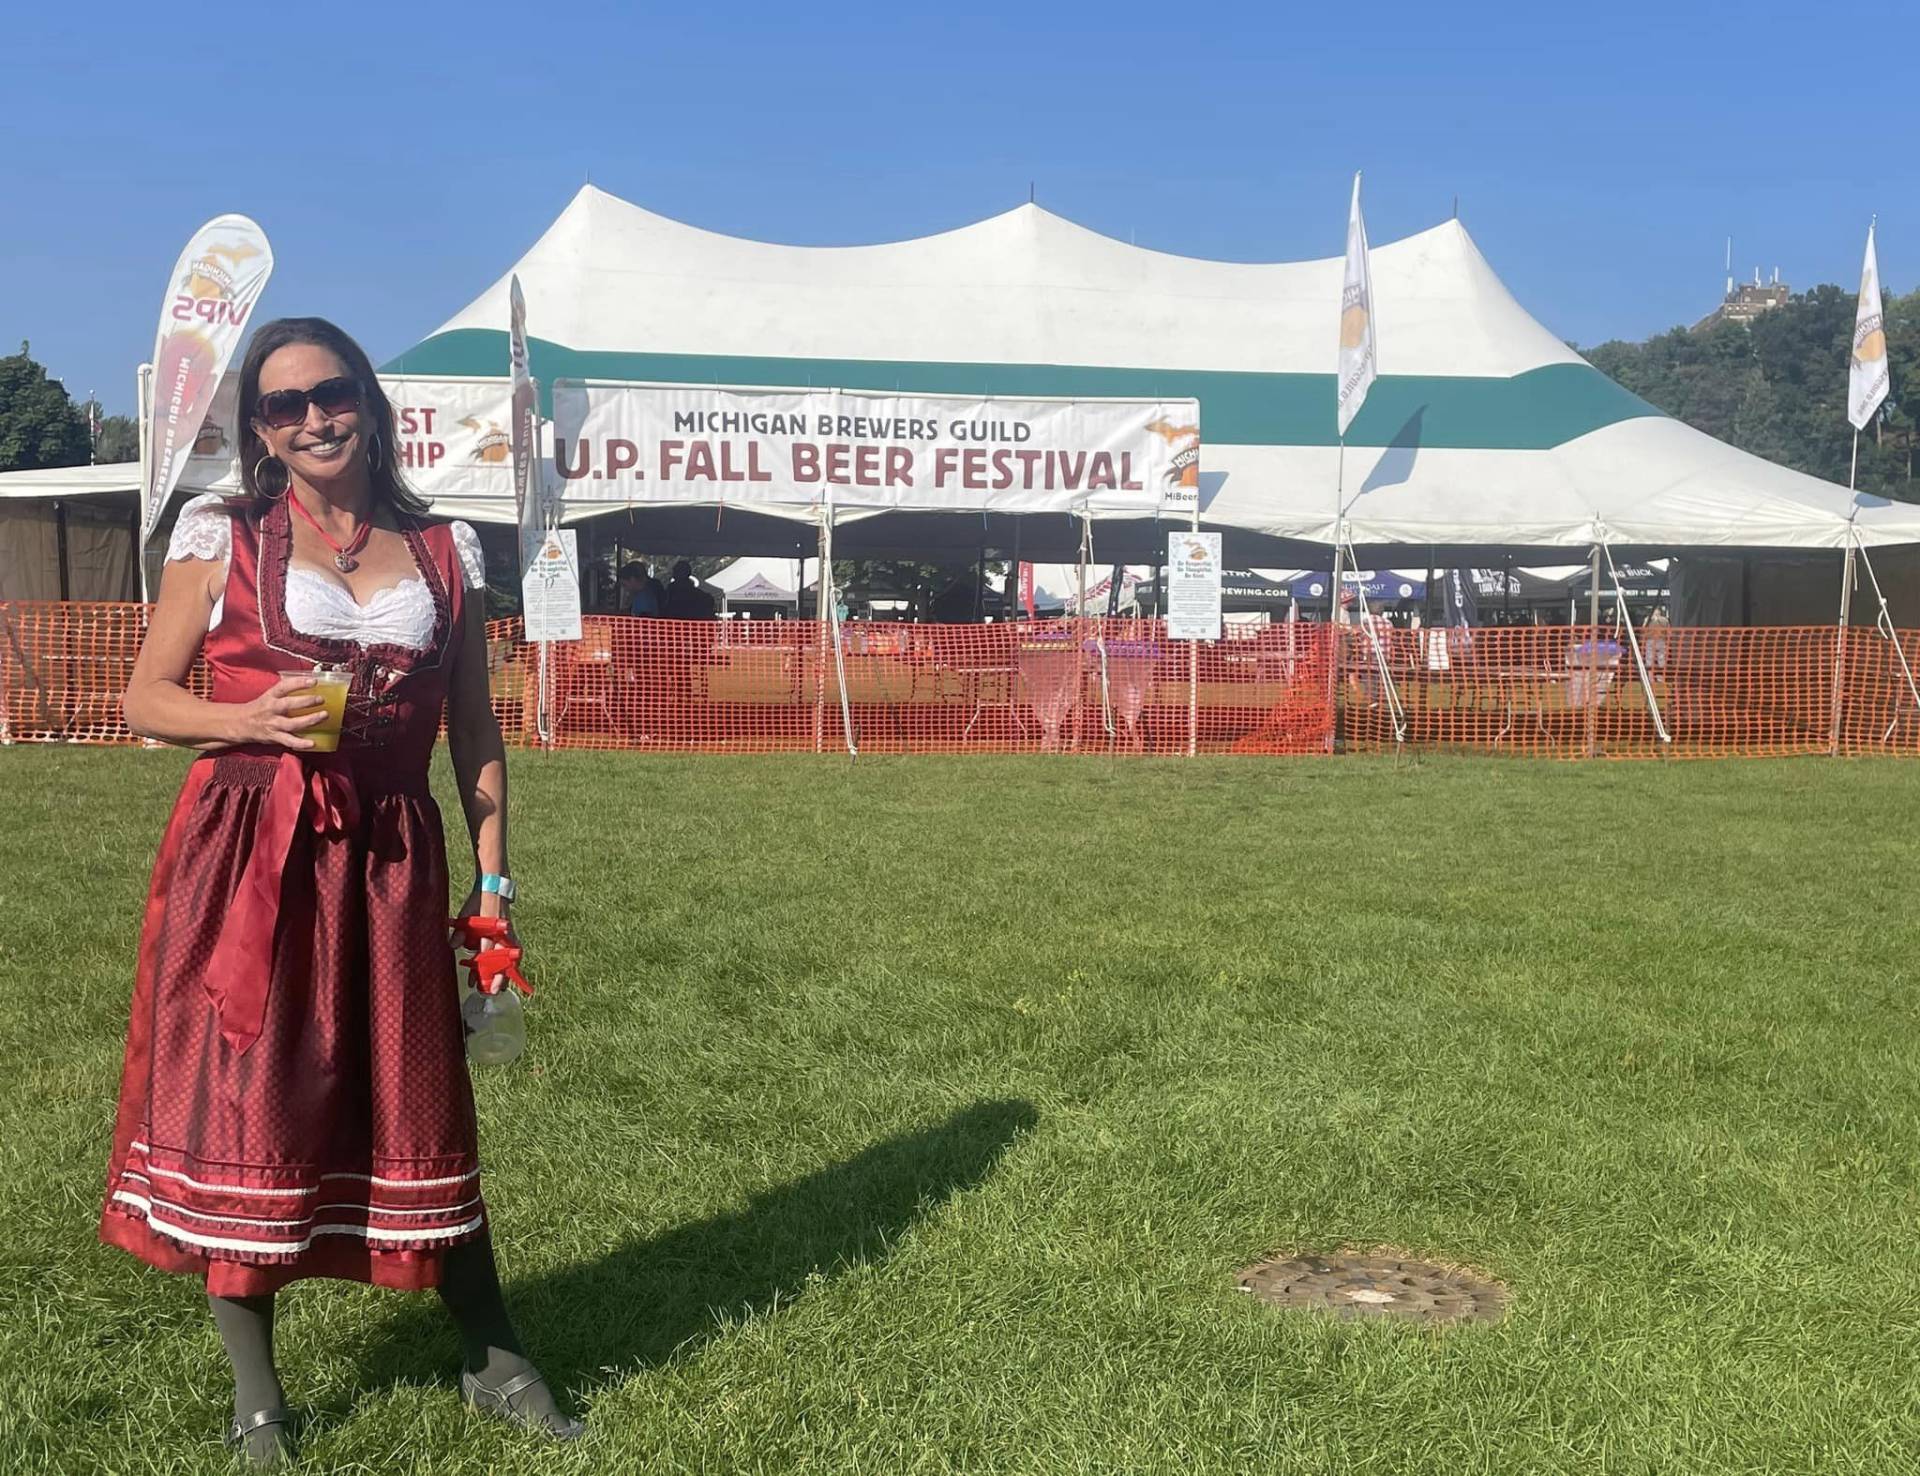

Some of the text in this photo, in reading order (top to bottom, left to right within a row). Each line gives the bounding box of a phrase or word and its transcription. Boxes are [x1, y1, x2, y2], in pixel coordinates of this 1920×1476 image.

[674, 411, 1032, 443] MICHIGAN BREWERS GUILD
[555, 438, 1143, 491] U.P. FALL BEER FESTIVAL
